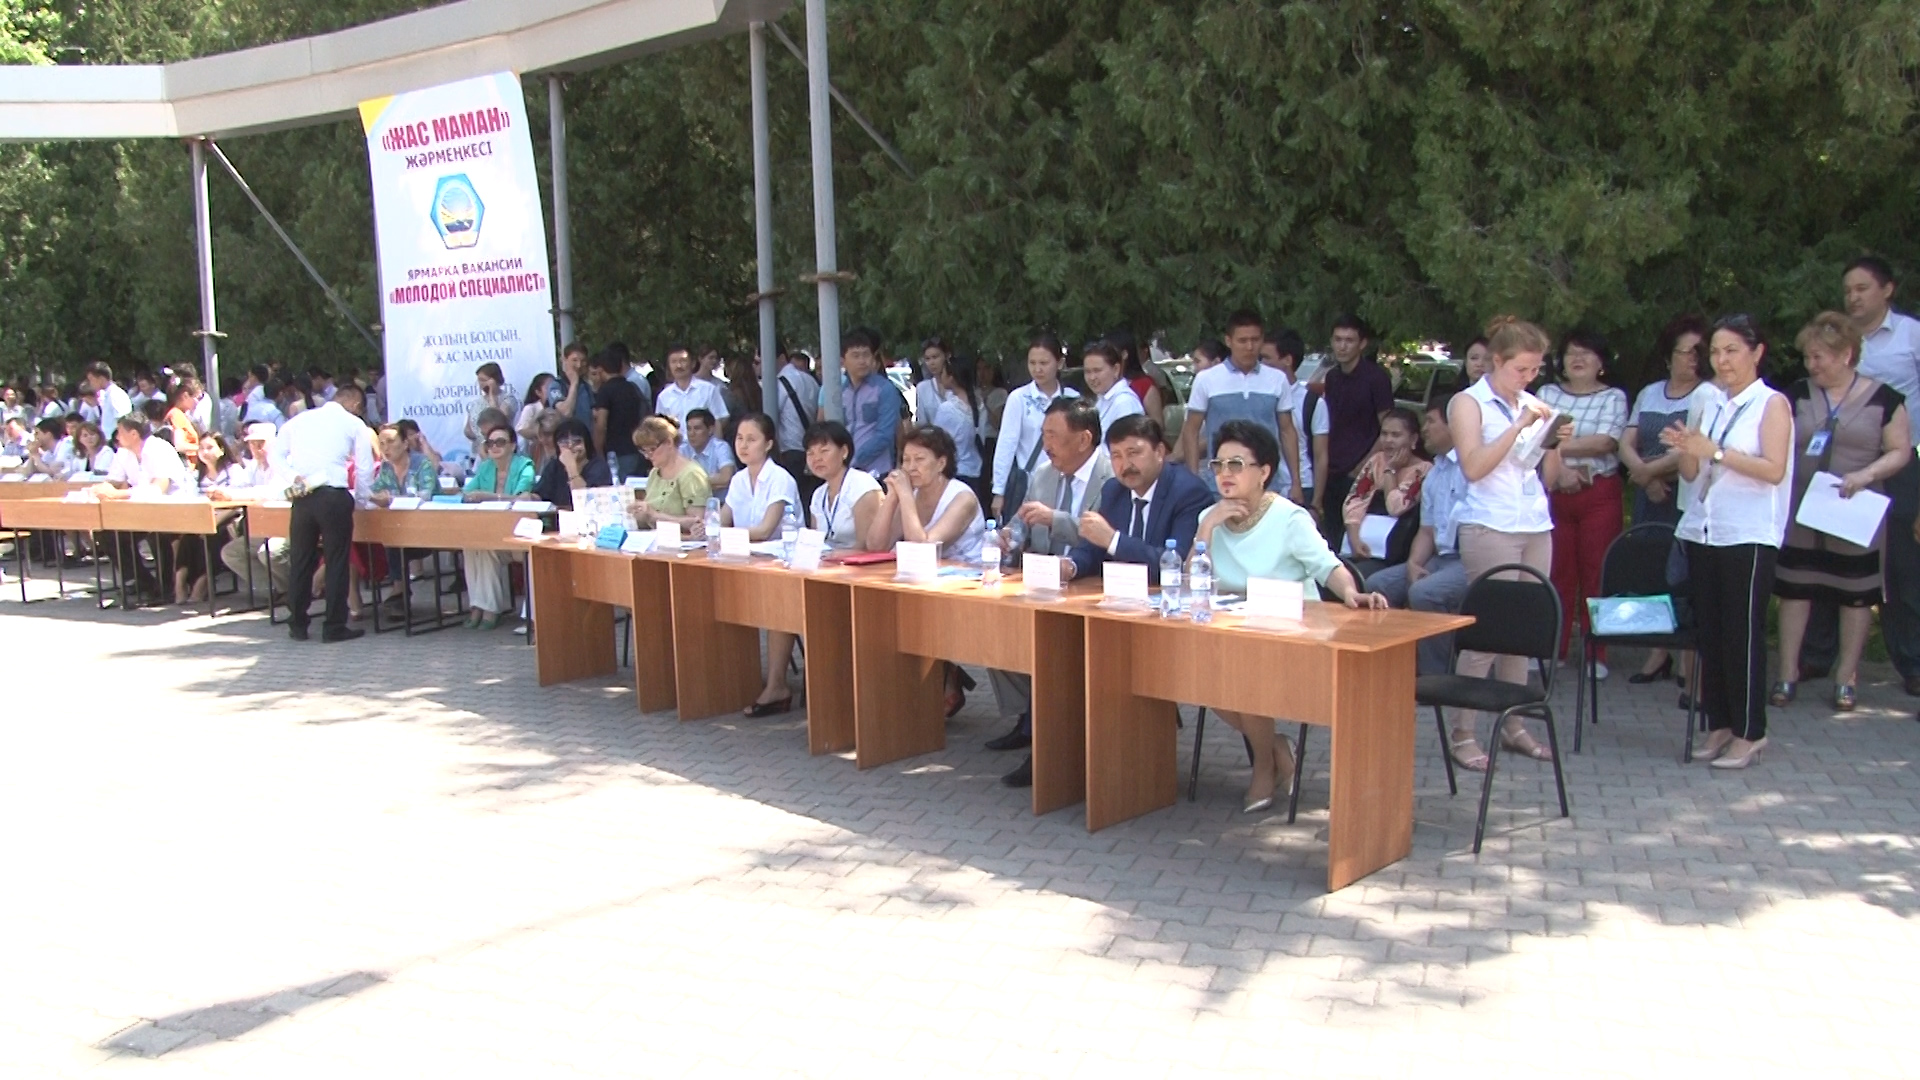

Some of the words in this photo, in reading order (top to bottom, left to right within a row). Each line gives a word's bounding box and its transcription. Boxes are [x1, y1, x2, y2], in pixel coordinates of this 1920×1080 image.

[407, 264, 459, 281] ЯРМАРКА
[462, 257, 523, 275] ВАКАНСИИ
[434, 351, 460, 364] ЖАС
[403, 400, 463, 418] МОЛОДОЙ
